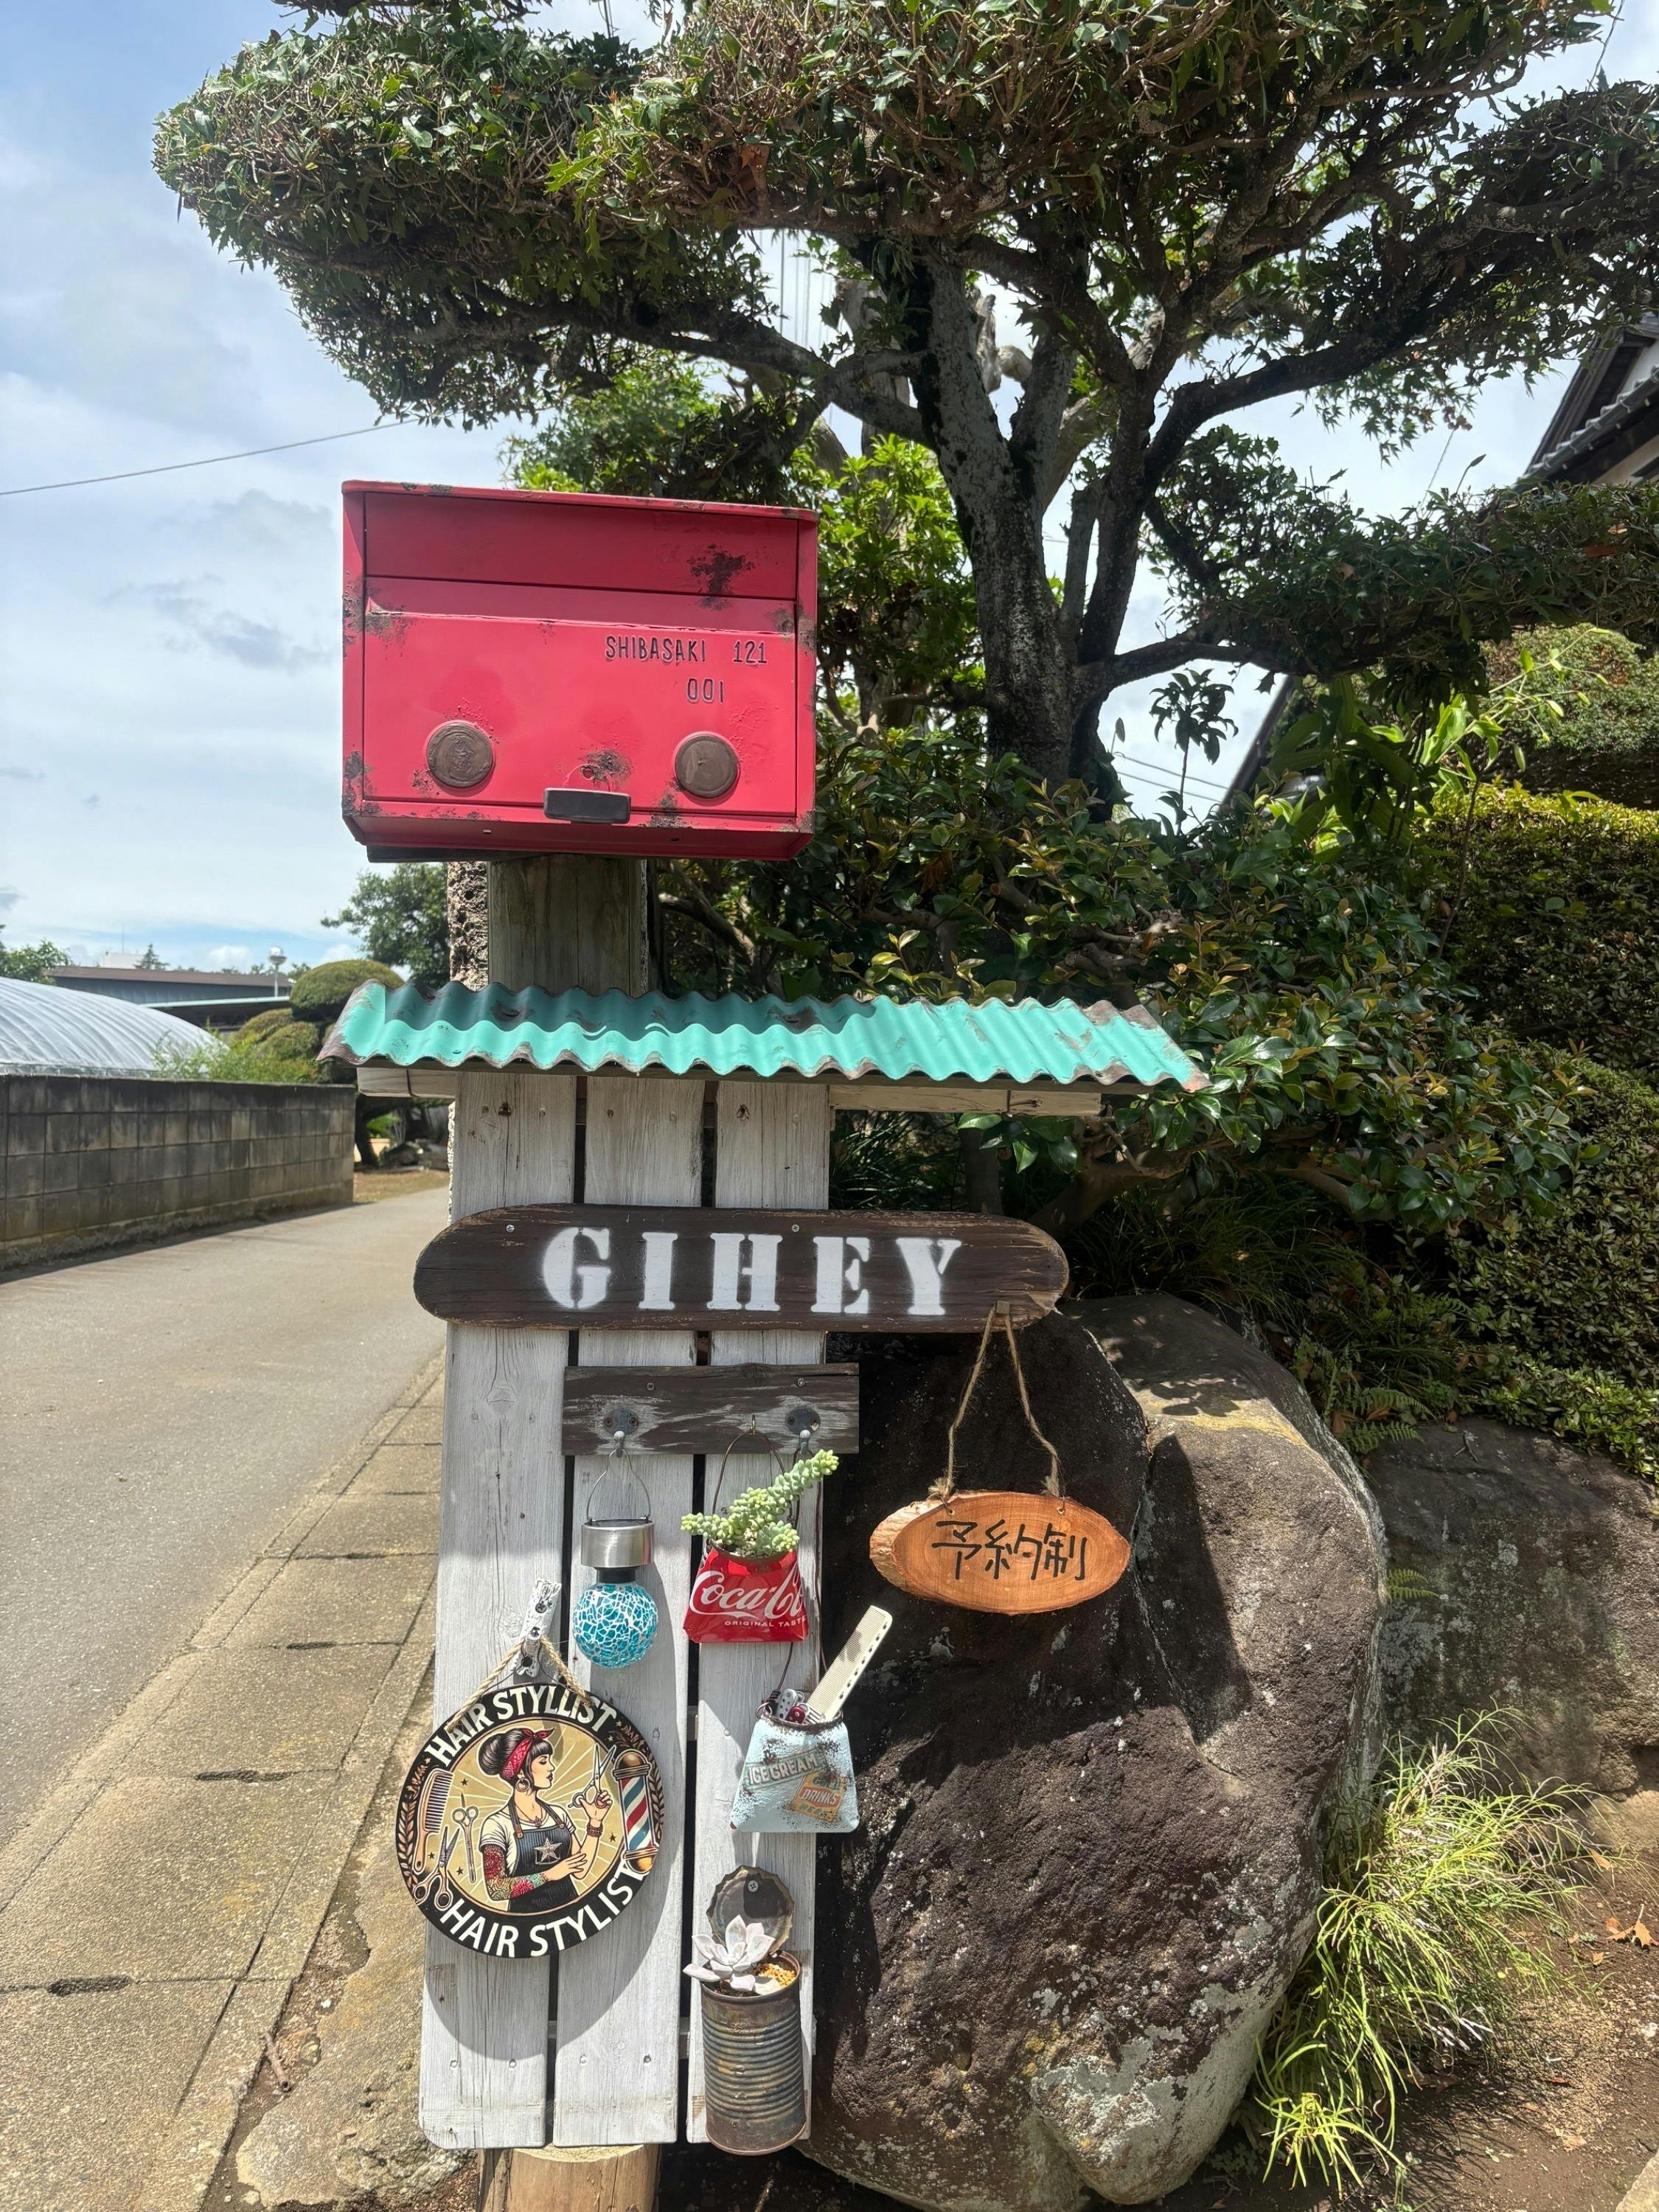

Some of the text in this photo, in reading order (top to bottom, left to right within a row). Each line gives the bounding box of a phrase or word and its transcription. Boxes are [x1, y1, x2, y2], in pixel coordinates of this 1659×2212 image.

[605, 635, 768, 664] SHIBASAKI 121
[542, 1226, 963, 1317] GIHEY
[931, 1519, 1088, 1581] 予約制
[424, 1700, 495, 1767] HAIR
[748, 1753, 819, 1785] ICE CREAM
[801, 1788, 839, 1806] DRINKS
[439, 1860, 651, 1958] HAIR STYLIST
